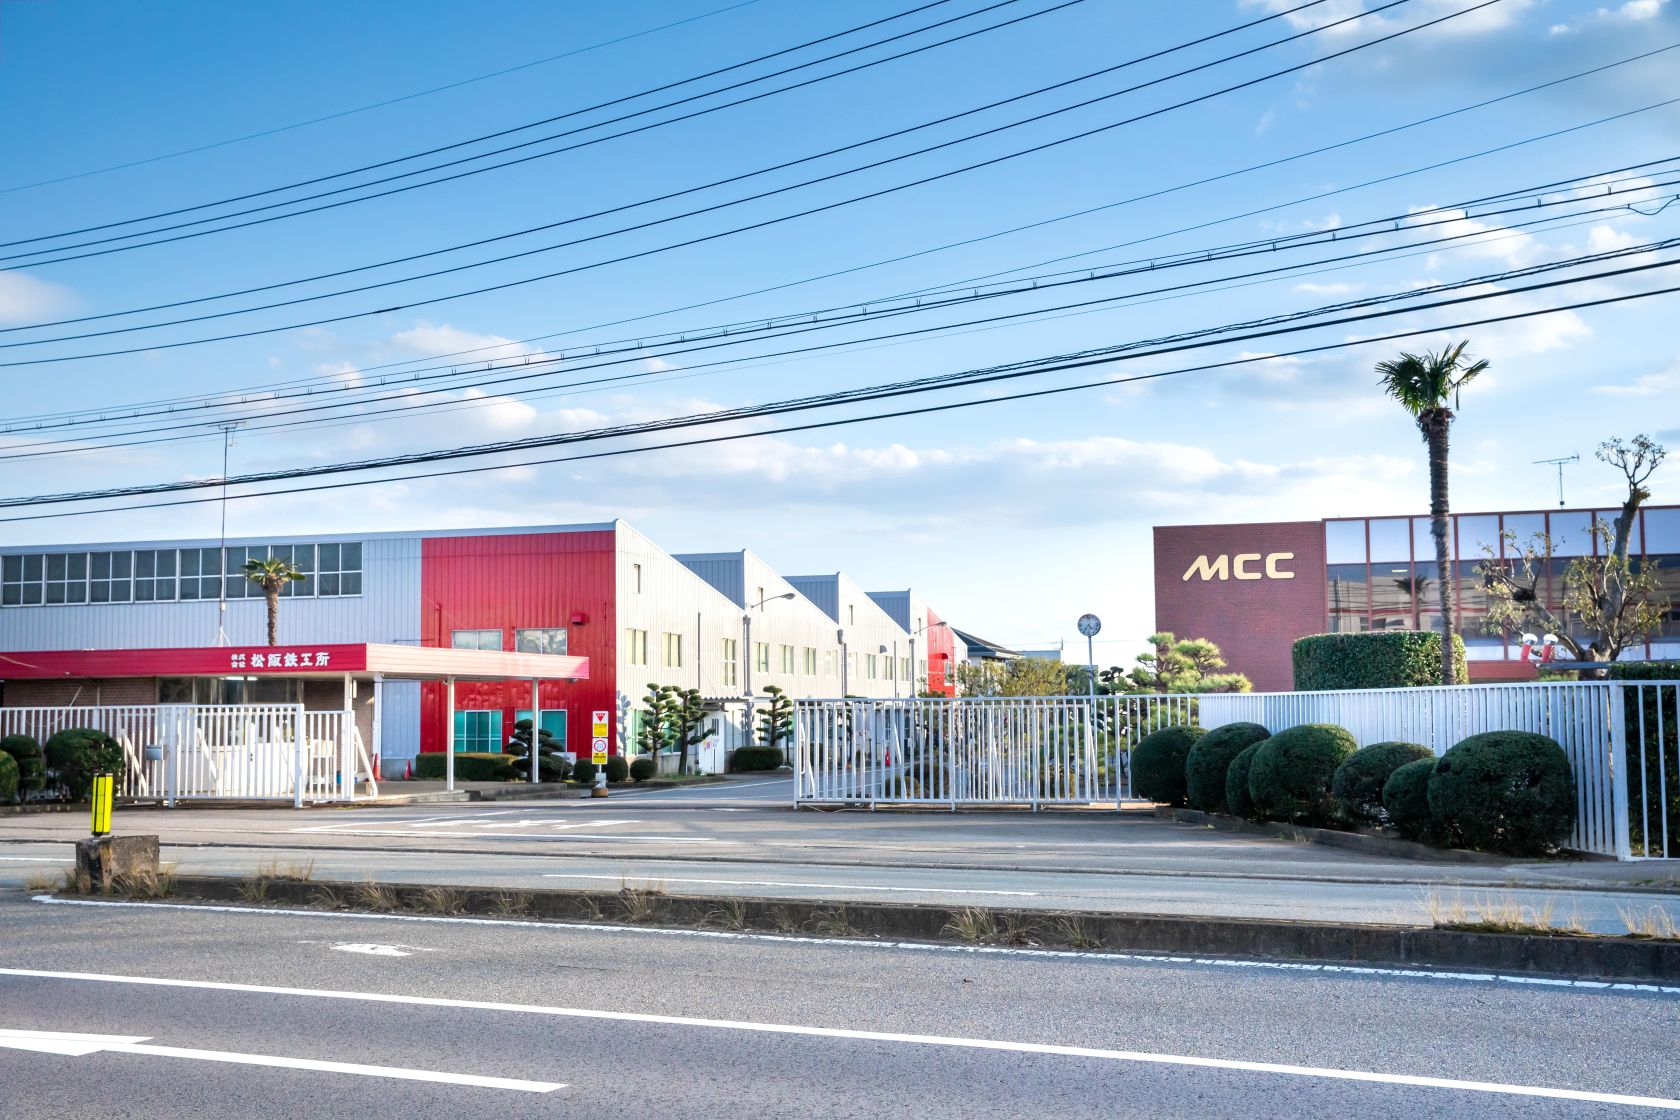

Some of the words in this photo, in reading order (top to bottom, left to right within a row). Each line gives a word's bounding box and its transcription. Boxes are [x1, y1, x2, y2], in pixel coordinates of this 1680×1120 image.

[1182, 552, 1295, 581] MCC
[250, 652, 330, 668] 松阪鉄工所
